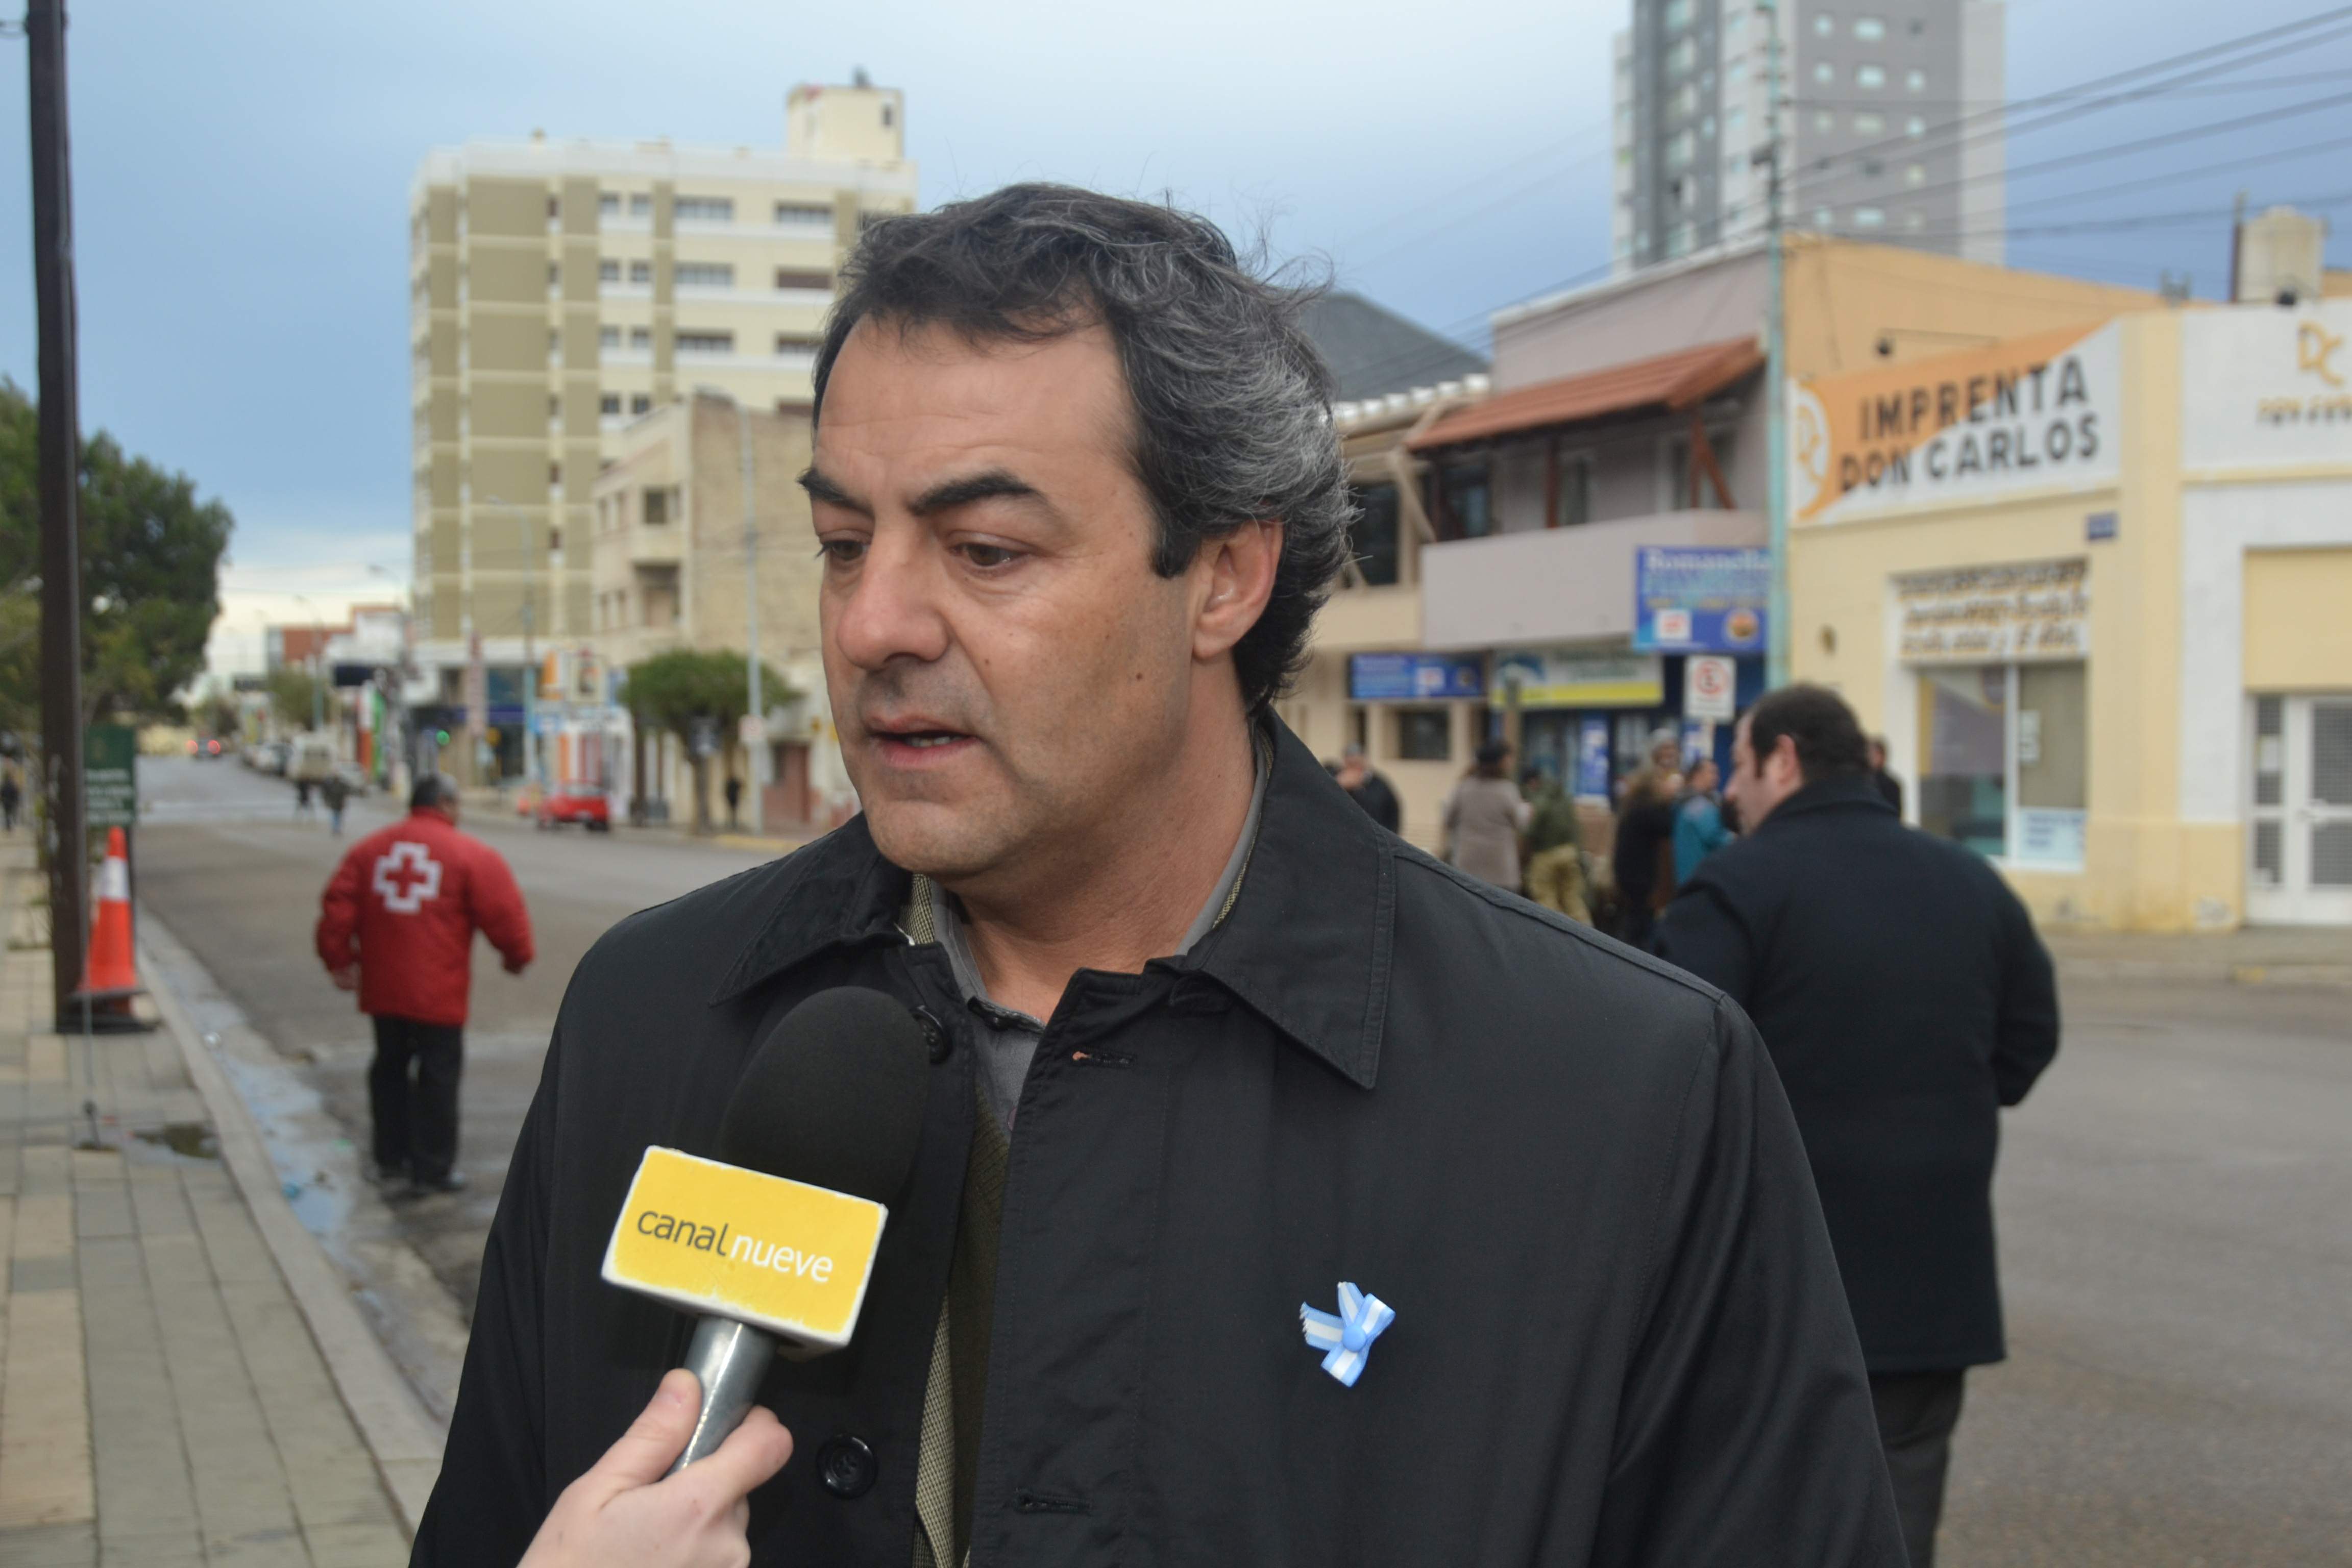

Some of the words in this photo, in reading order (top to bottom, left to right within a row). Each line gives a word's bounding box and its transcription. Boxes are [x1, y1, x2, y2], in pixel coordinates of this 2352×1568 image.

[1858, 356, 2089, 441] IMPRENTA
[1839, 442, 1911, 493] DON
[1923, 412, 2099, 480] CARLOS
